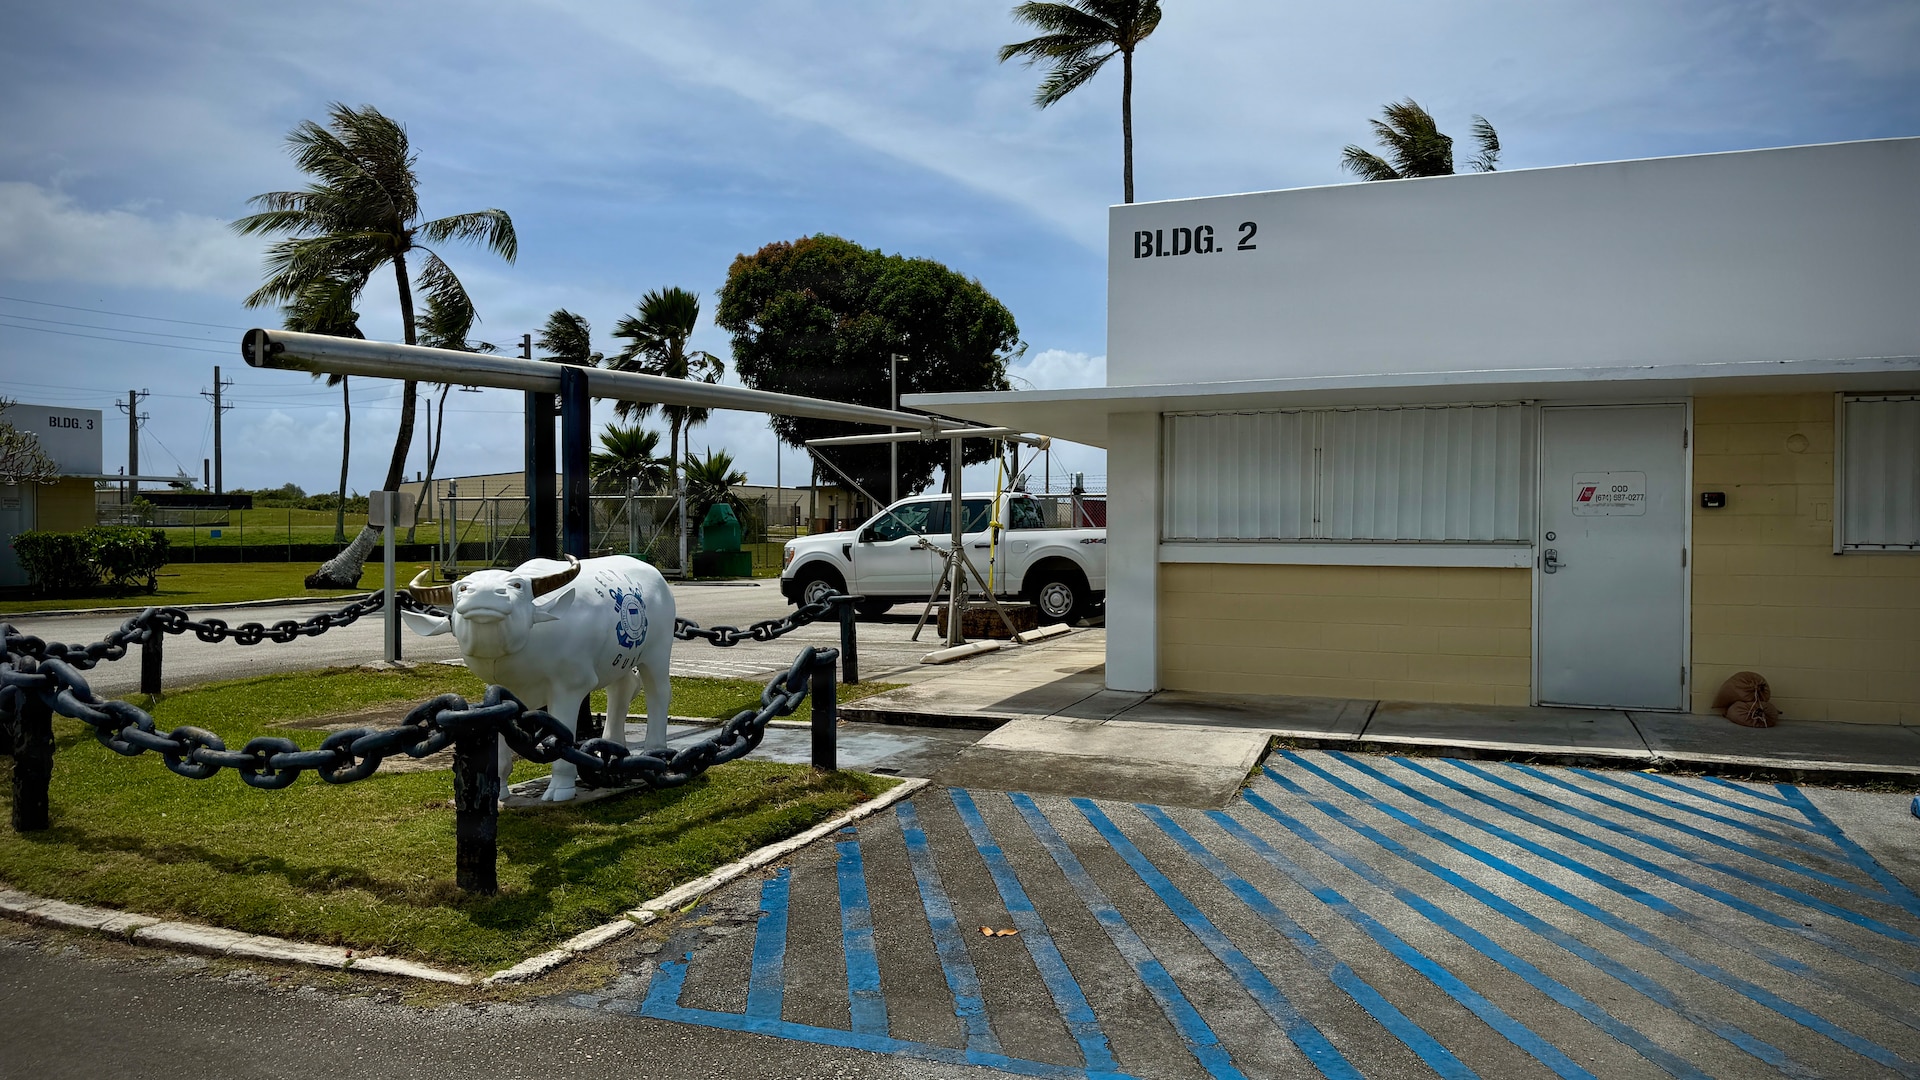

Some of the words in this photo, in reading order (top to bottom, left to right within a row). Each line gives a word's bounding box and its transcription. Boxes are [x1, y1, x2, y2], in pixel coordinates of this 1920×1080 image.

[1134, 225, 1223, 259] BLDG.
[1237, 221, 1258, 251] 2
[49, 416, 82, 429] BLDG.
[86, 419, 94, 430] 3
